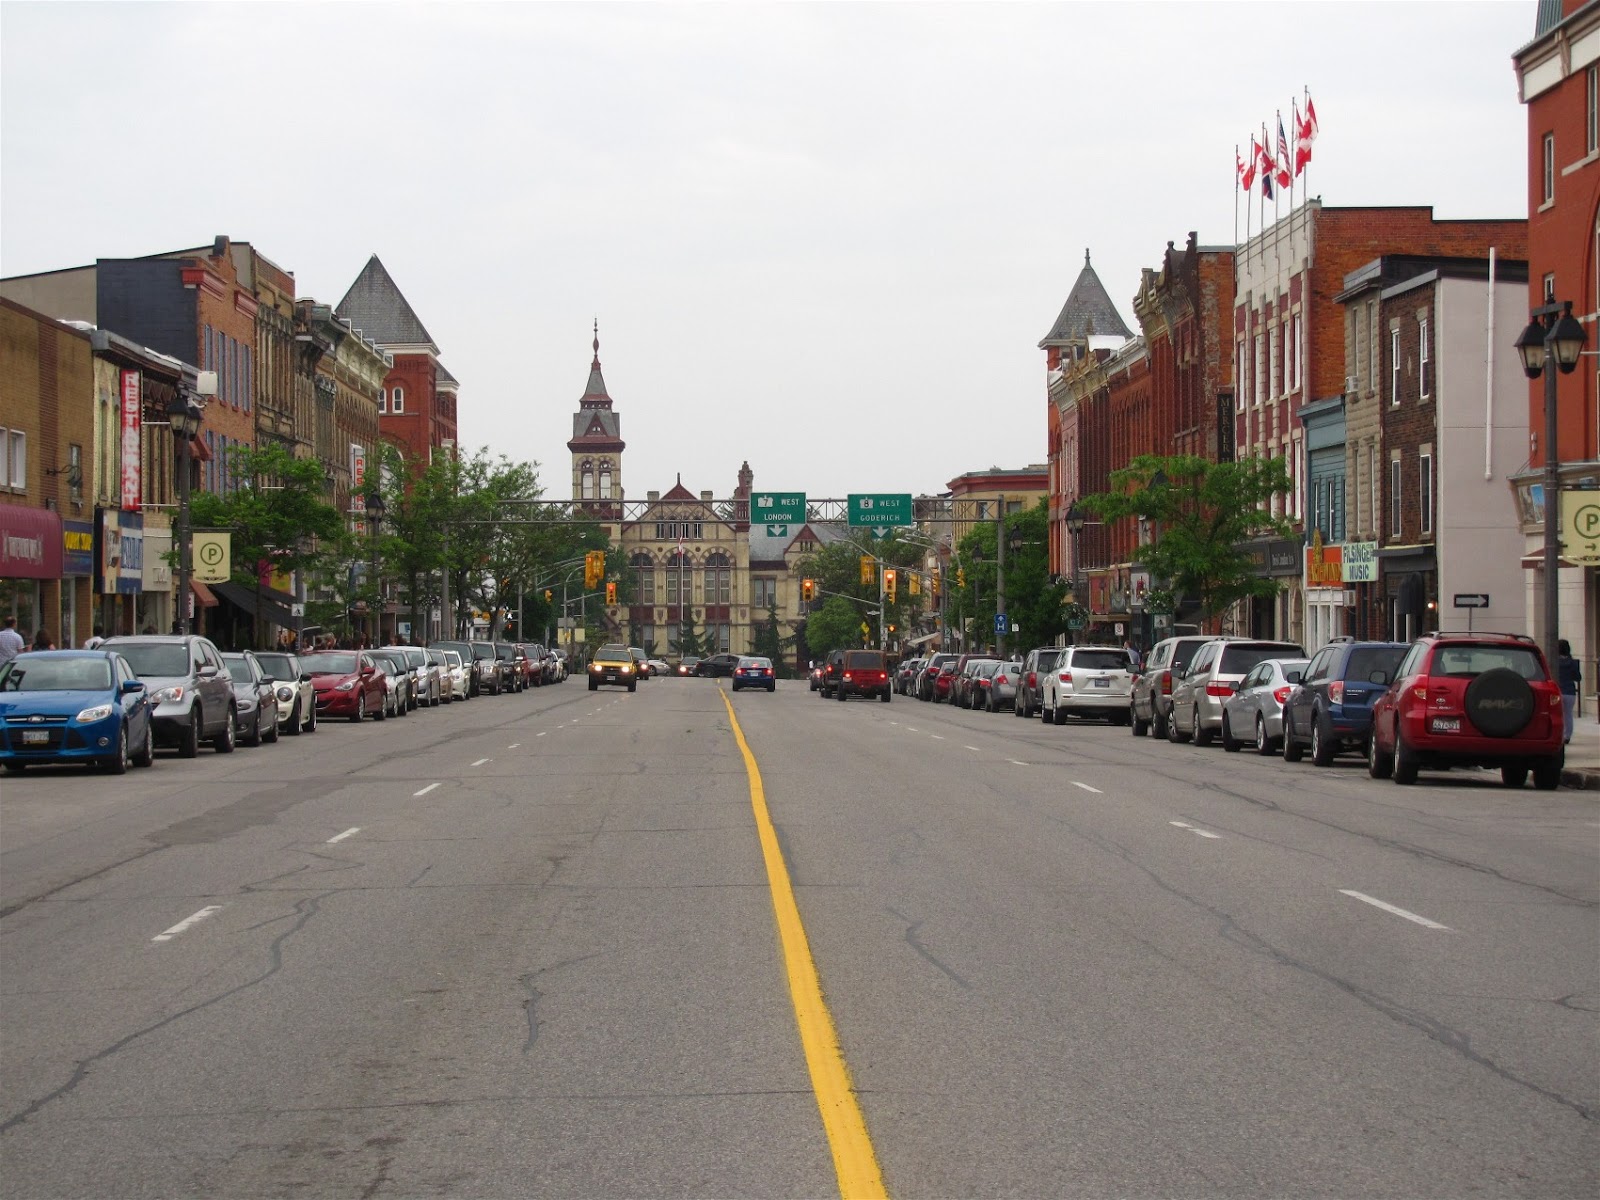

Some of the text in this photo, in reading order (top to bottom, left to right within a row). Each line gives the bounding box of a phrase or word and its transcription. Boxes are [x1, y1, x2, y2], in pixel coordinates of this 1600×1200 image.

[763, 498, 799, 507] 7 WEST
[863, 499, 900, 508] 8 WEST
[764, 513, 792, 521] LONDON
[860, 514, 900, 522] GODERICH
[1586, 513, 1599, 532] P
[208, 547, 217, 561] P
[1349, 564, 1370, 580] MUSIC
